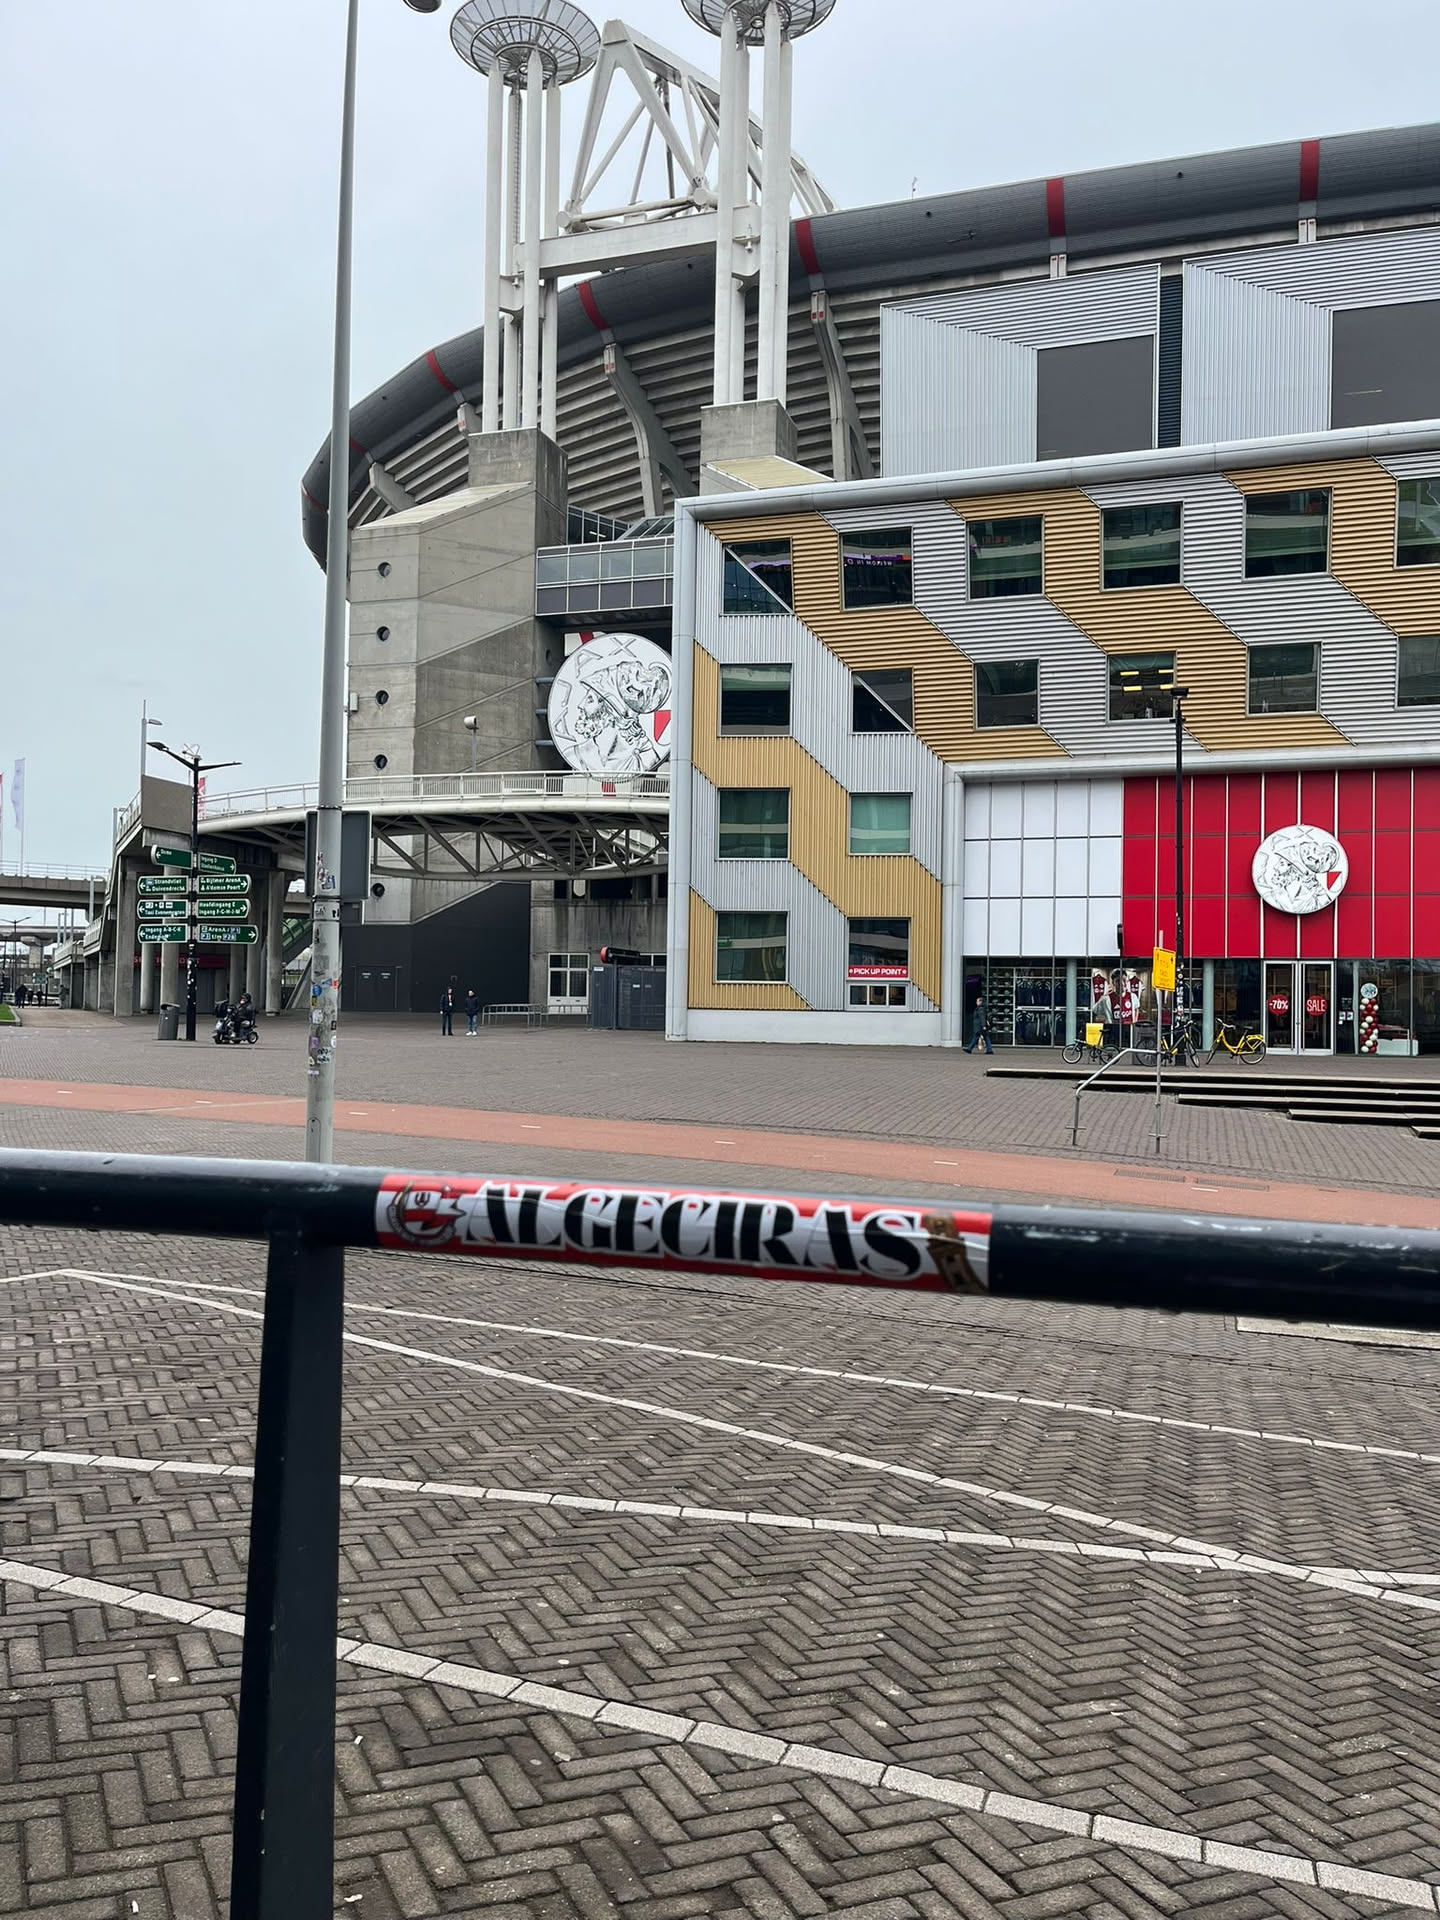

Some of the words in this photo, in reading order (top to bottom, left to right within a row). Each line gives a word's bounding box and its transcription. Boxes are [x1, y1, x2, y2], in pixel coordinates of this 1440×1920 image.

[552, 637, 637, 742] AJAX
[1269, 998, 1289, 1010] -70%
[1306, 999, 1326, 1012] SALE
[463, 1182, 922, 1279] ALGECIRAS
